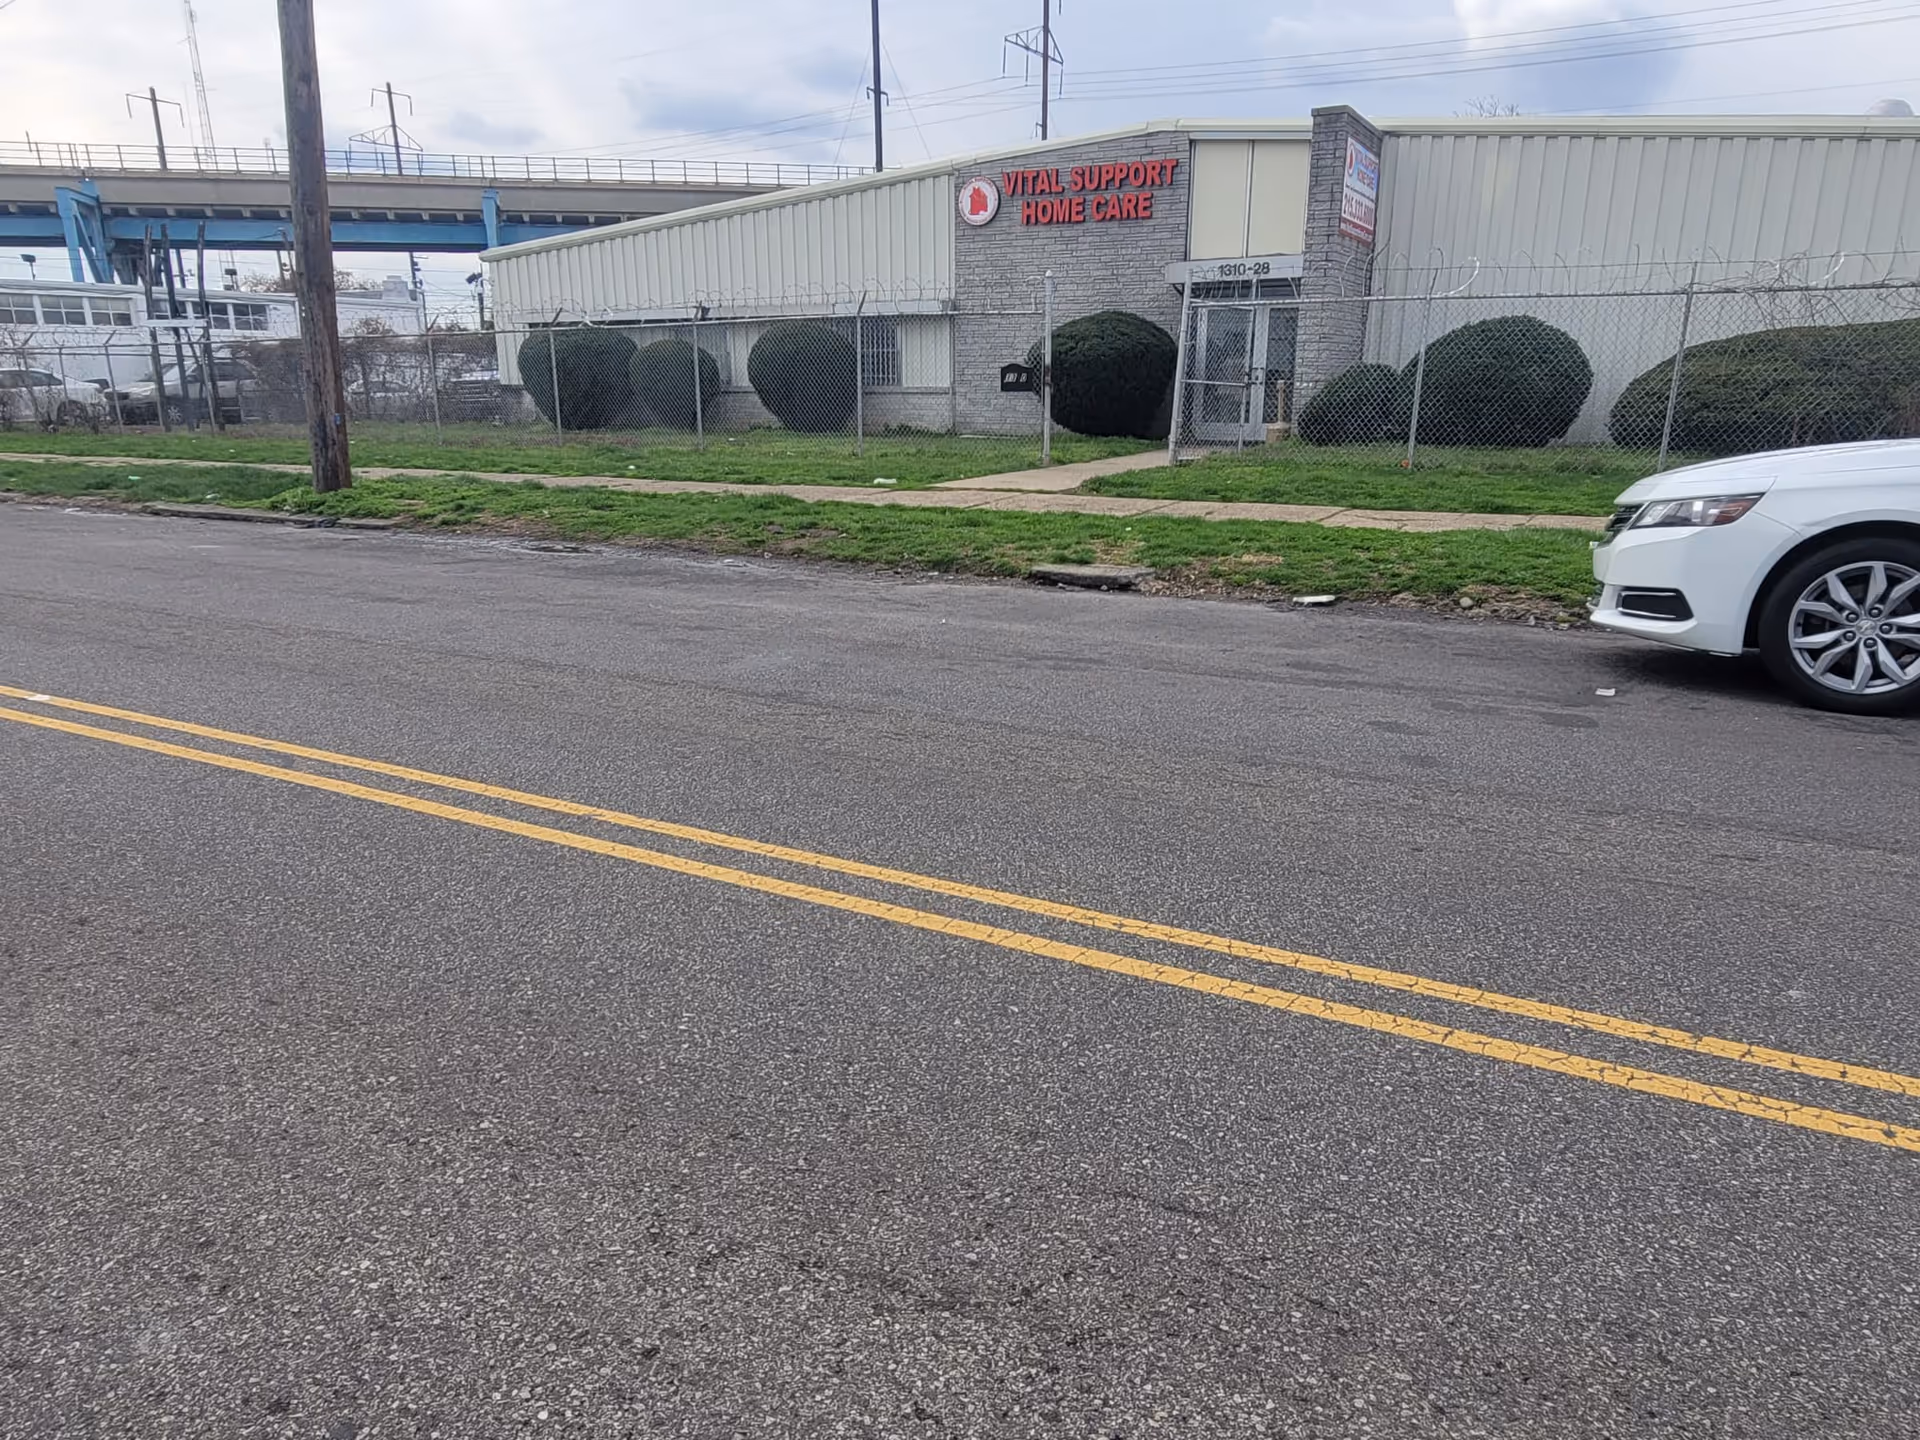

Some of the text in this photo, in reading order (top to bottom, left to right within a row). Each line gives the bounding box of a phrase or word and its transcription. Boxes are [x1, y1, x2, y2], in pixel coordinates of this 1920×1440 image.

[1002, 169, 1064, 197] VITAL
[1070, 159, 1178, 192] SUPPORT
[1021, 196, 1086, 225] HOME
[1092, 192, 1153, 222] CARE
[1218, 262, 1271, 277] 1310-28
